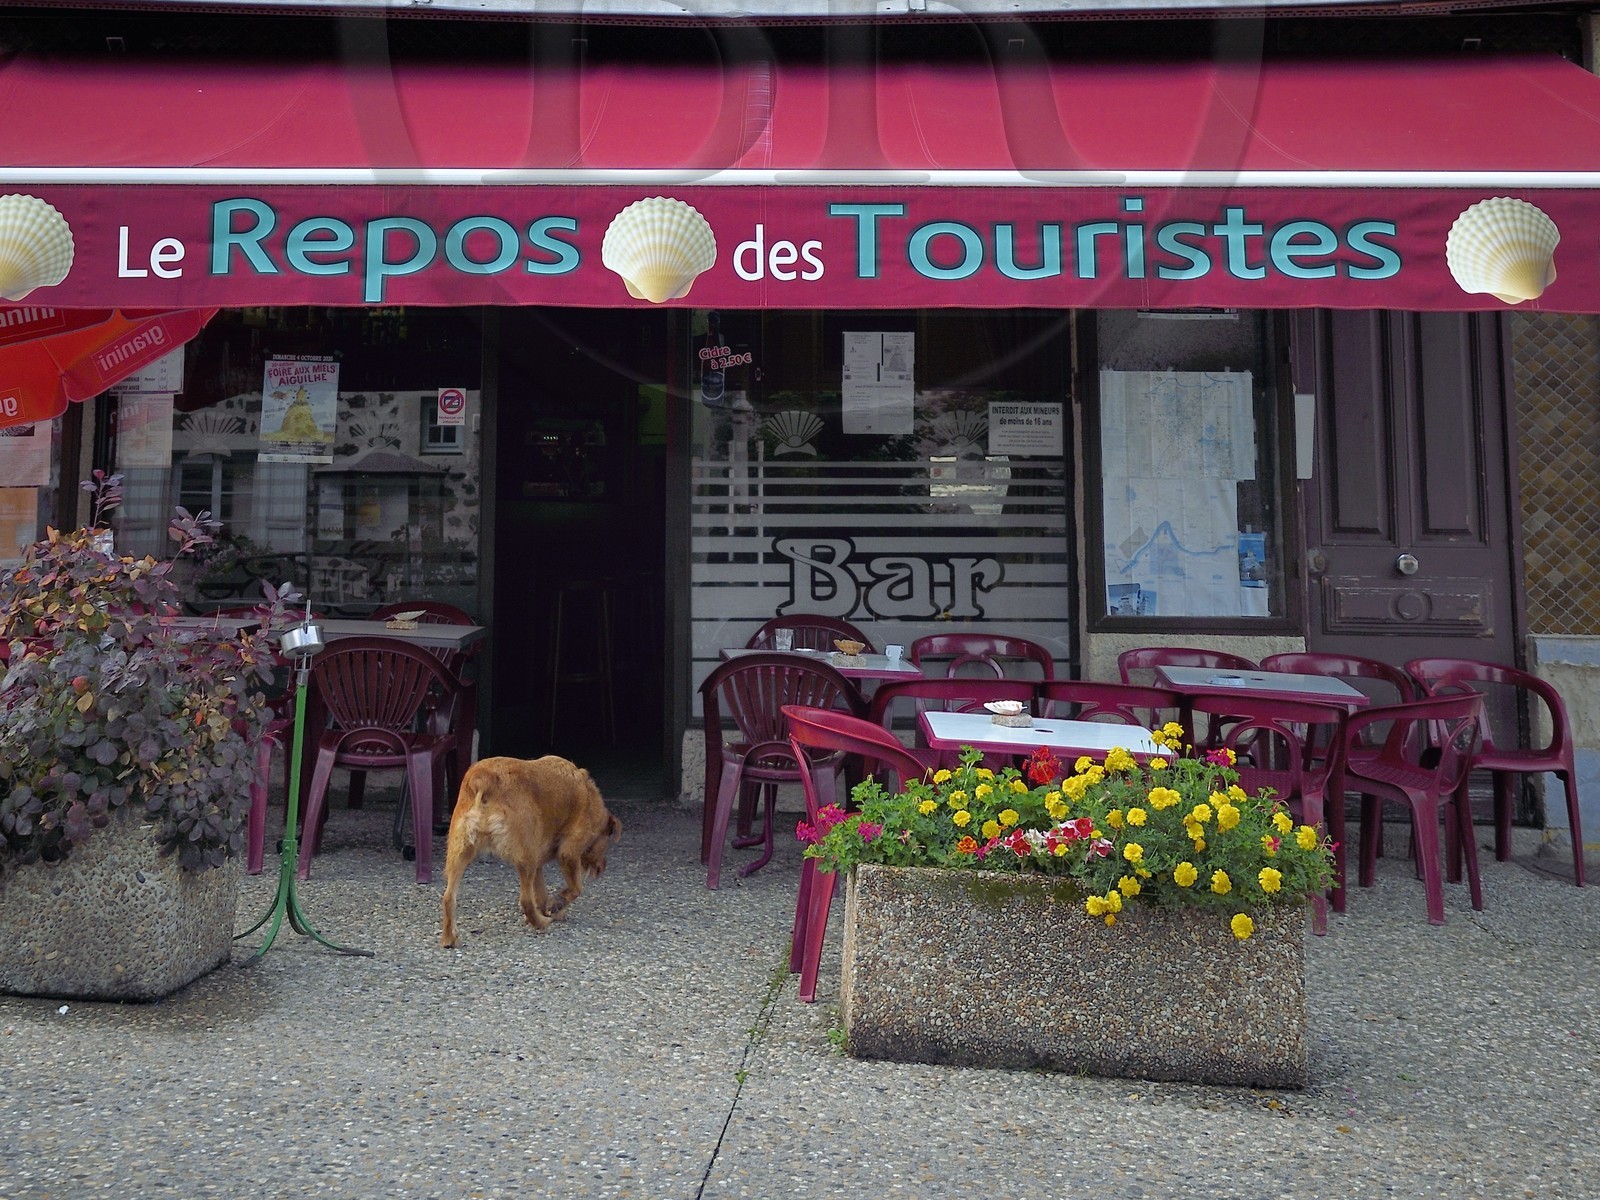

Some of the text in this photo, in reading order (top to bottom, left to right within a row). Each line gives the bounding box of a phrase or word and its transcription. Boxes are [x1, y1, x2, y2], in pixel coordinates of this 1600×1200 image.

[118, 196, 1403, 302] Le Repos des Touristes
[699, 346, 731, 359] Cidre
[711, 359, 719, 369] à
[294, 367, 310, 376] AUX
[992, 406, 1060, 415] INTERDIT AUX MINEURS
[1000, 417, 1007, 425] de
[1008, 417, 1024, 425] moins
[1025, 417, 1033, 425] de
[771, 536, 1004, 619] Bar
